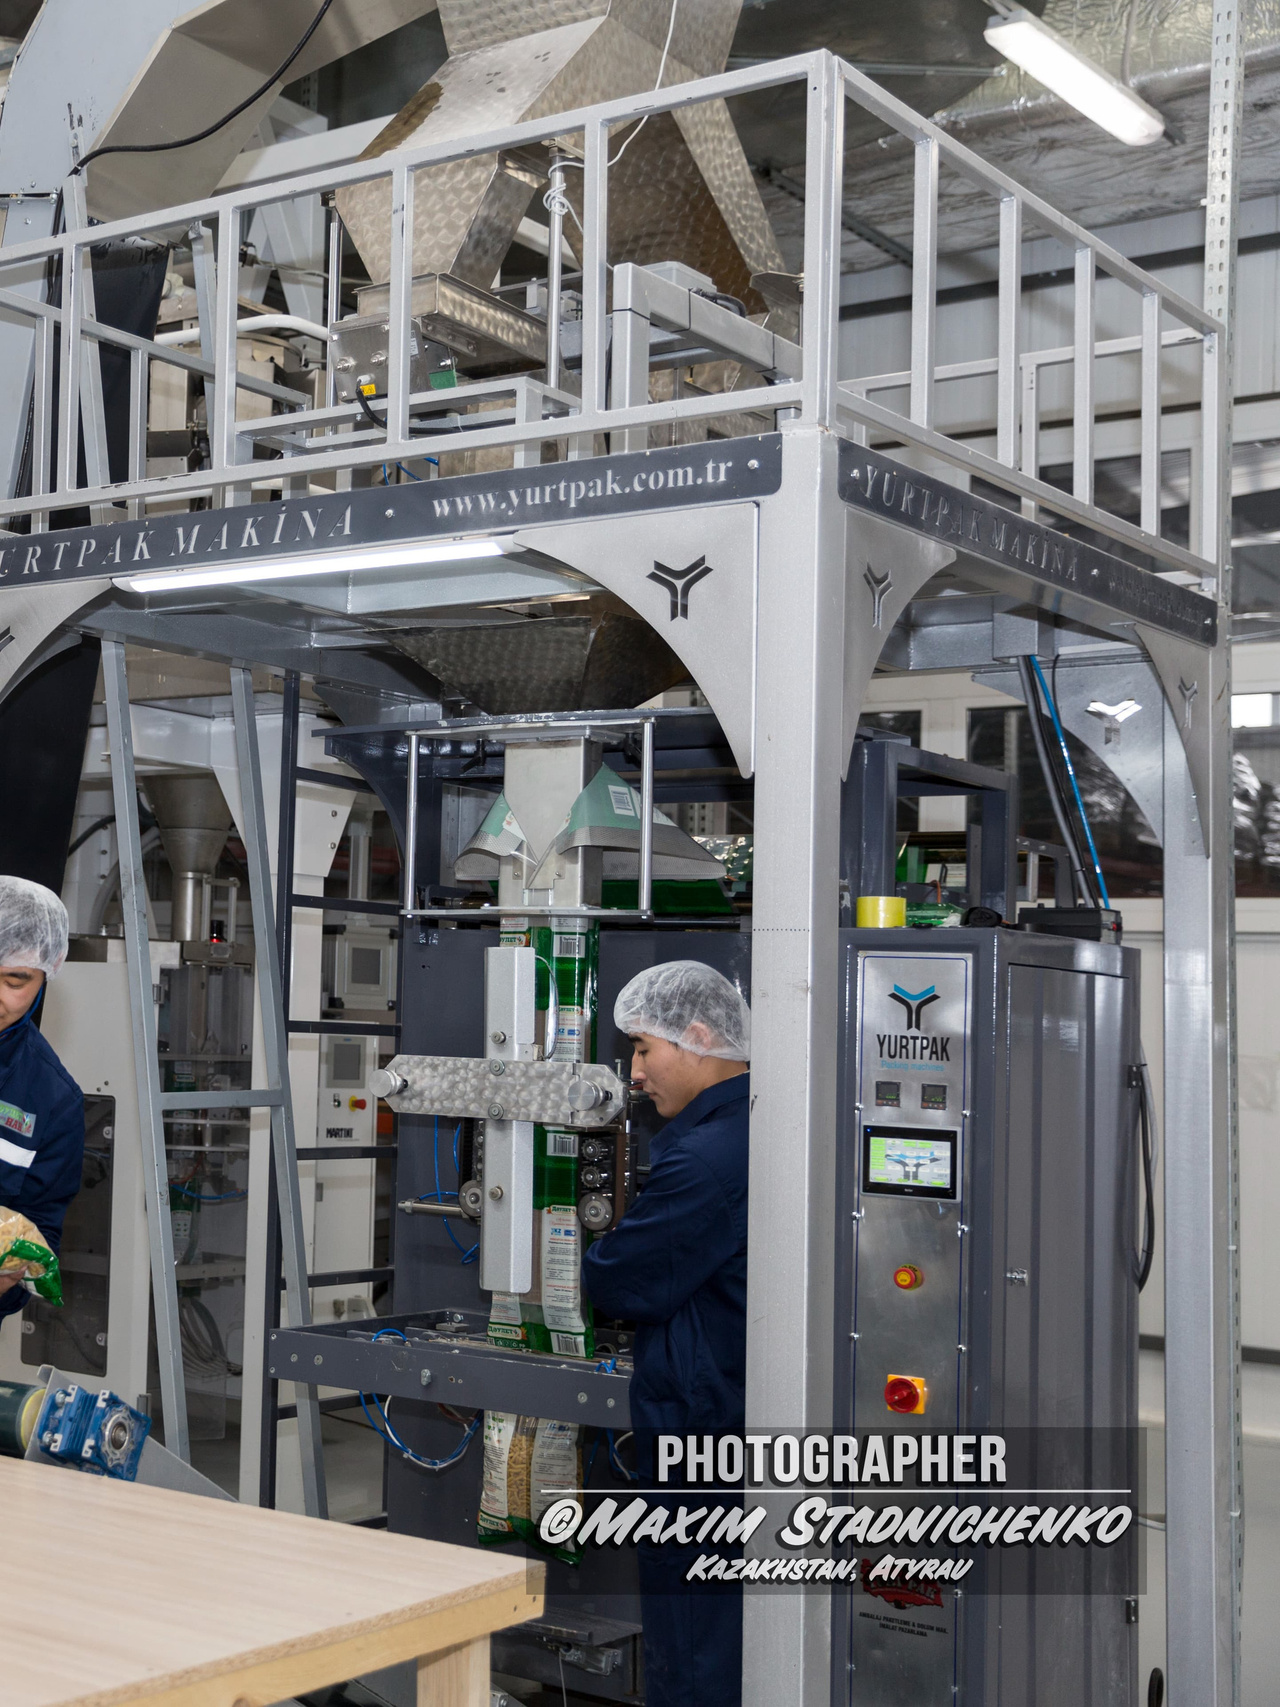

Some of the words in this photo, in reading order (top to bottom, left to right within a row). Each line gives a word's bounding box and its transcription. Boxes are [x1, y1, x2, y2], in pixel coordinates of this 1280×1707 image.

[169, 505, 353, 557] MAKİNA
[432, 458, 733, 517] www.yurtpak.com.tr
[862, 463, 984, 543] YURTPAK
[991, 516, 1080, 582] MAKİNA
[876, 1033, 951, 1062] YURTPAK
[881, 1059, 909, 1072] Packing
[910, 1061, 945, 1072] machines
